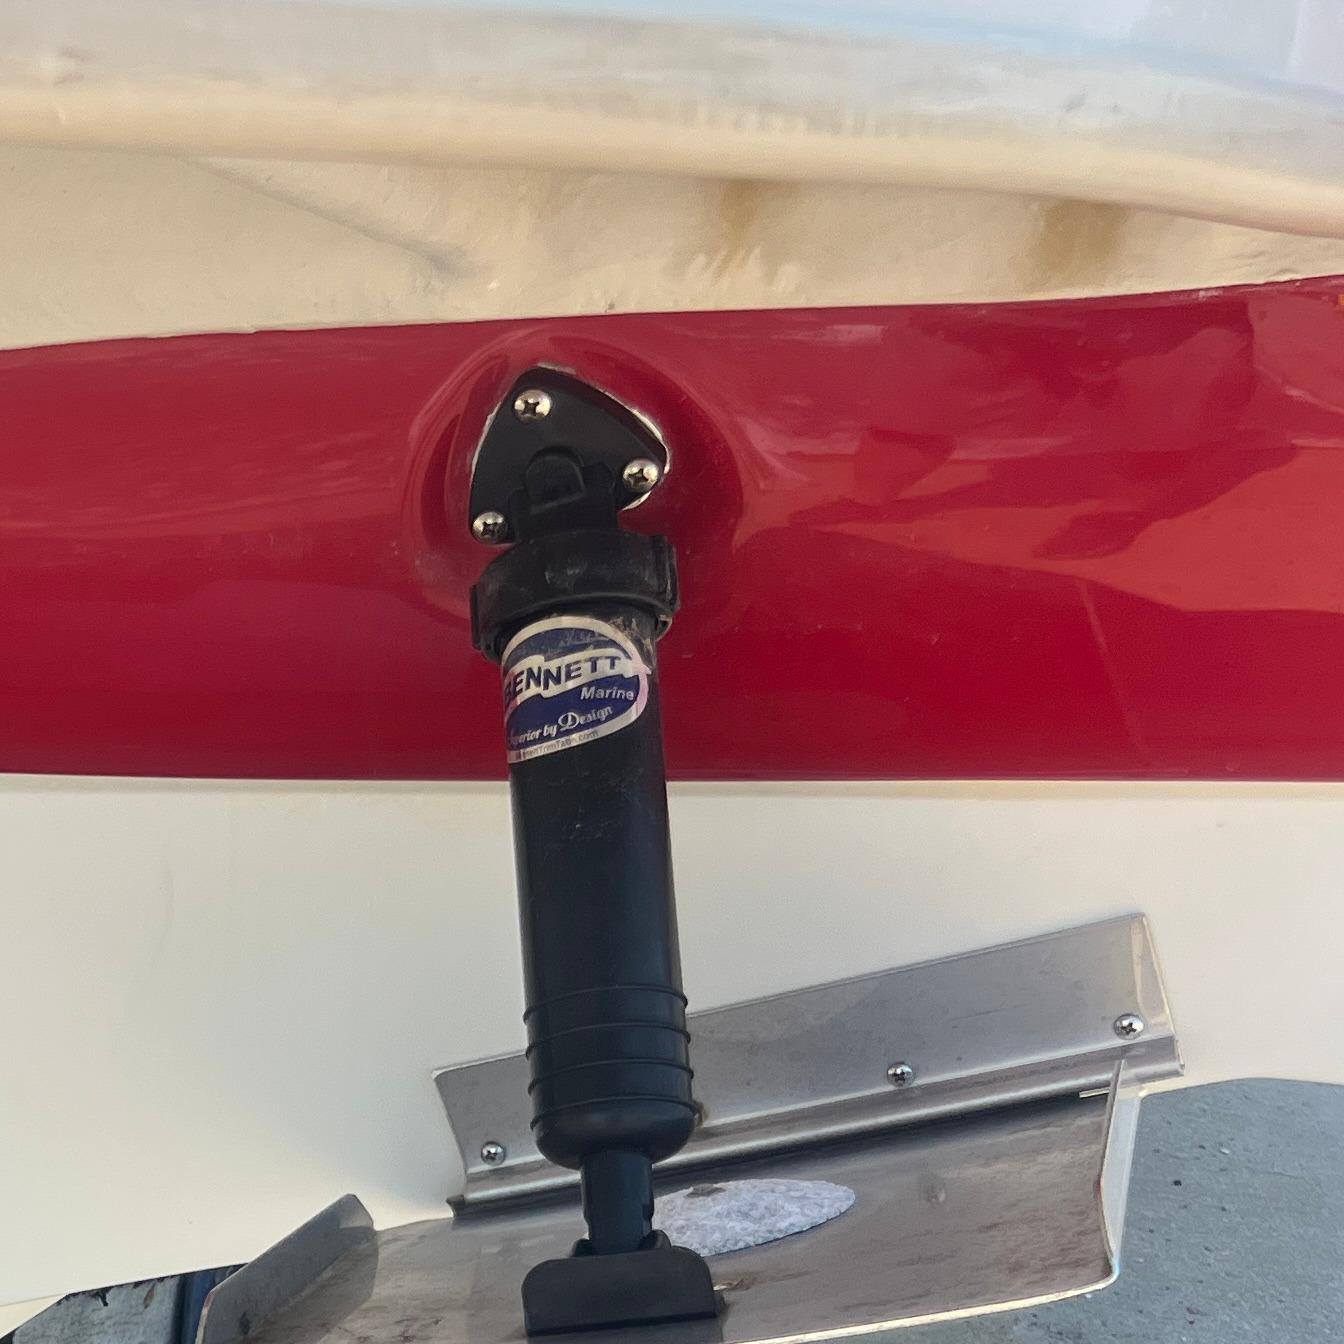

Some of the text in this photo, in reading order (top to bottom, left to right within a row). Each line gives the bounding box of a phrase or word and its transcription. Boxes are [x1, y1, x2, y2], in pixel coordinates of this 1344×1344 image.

[580, 687, 634, 700] Marine
[543, 724, 557, 737] by
[558, 706, 613, 731] Design
